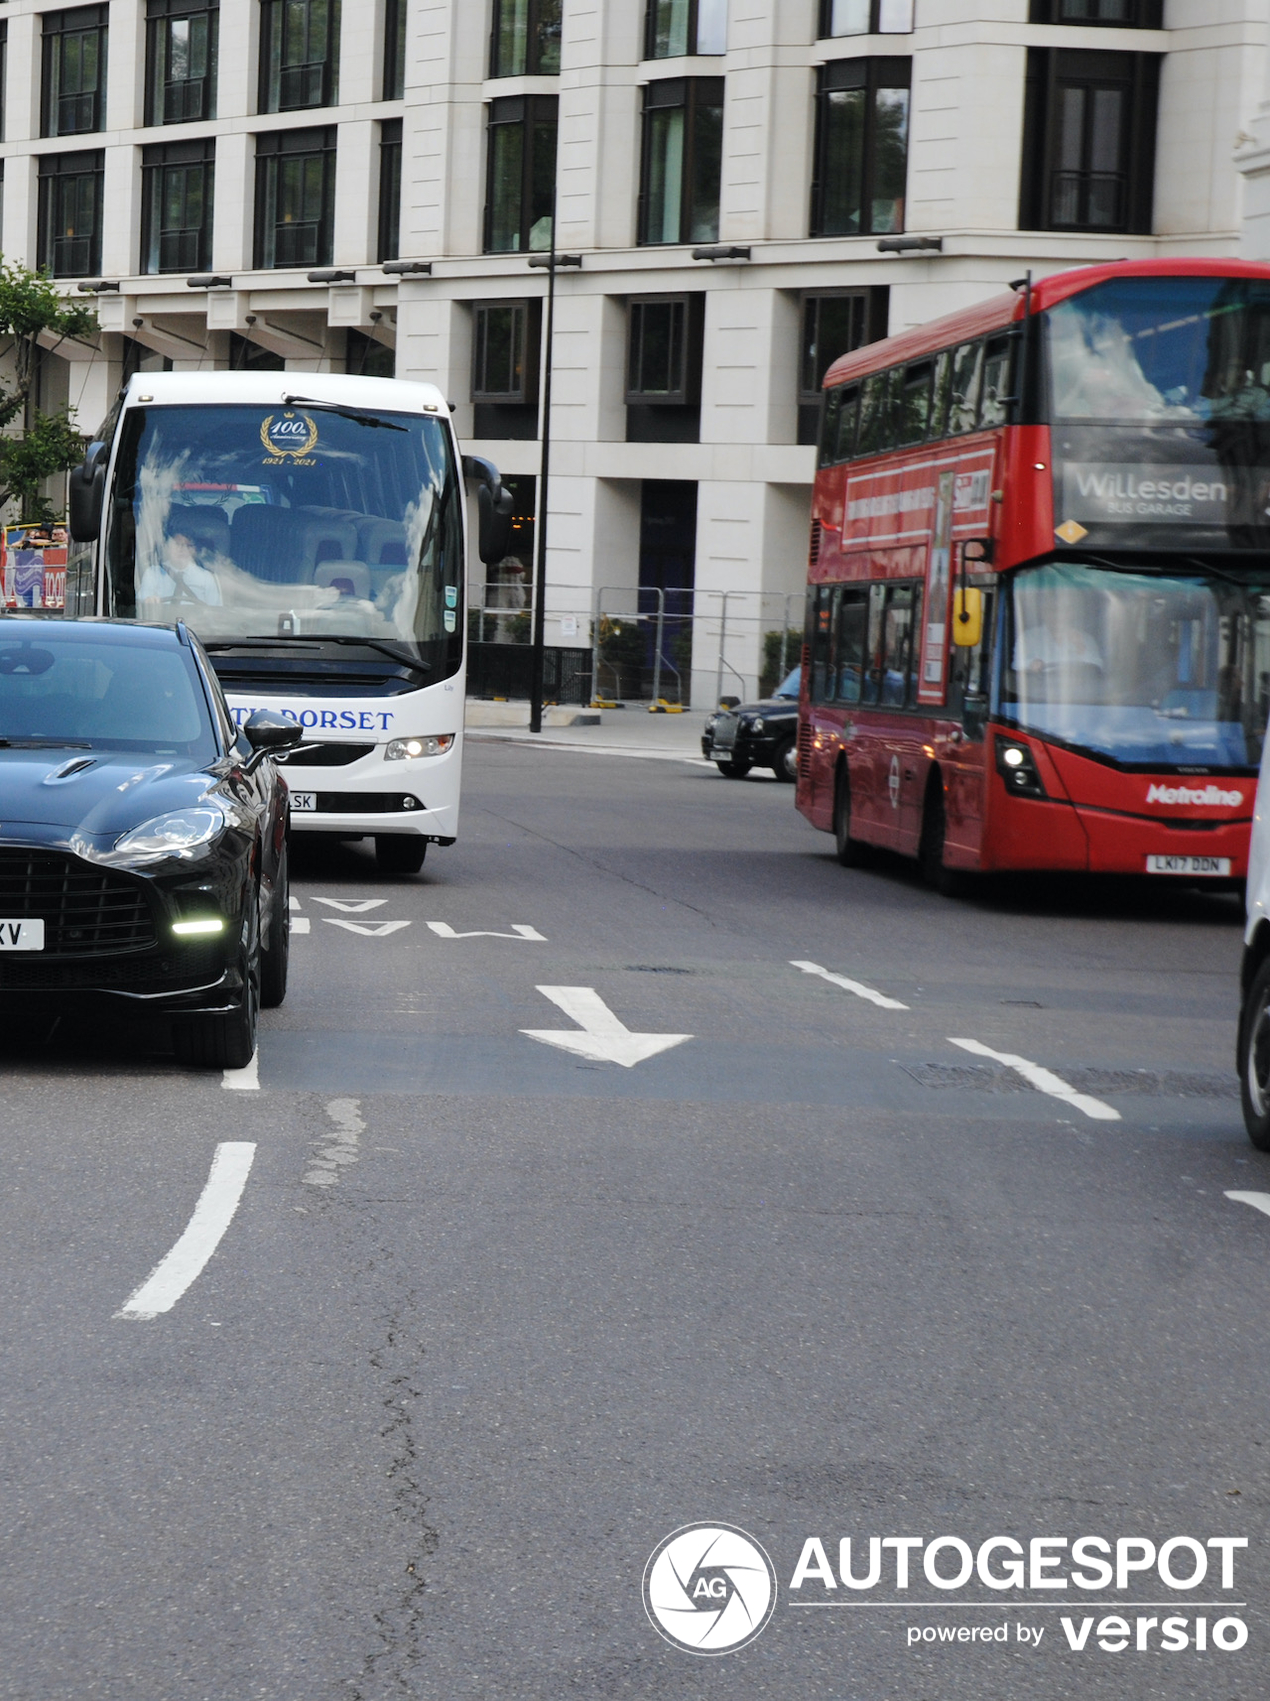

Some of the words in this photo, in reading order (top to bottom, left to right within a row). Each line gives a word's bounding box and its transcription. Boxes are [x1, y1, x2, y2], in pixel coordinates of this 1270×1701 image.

[1076, 472, 1227, 502] Willesden
[1108, 501, 1132, 514] BUS
[1136, 502, 1193, 517] GARAGE
[1146, 783, 1244, 807] Metroline
[1155, 857, 1187, 870] LK17
[1192, 858, 1220, 871] DDN
